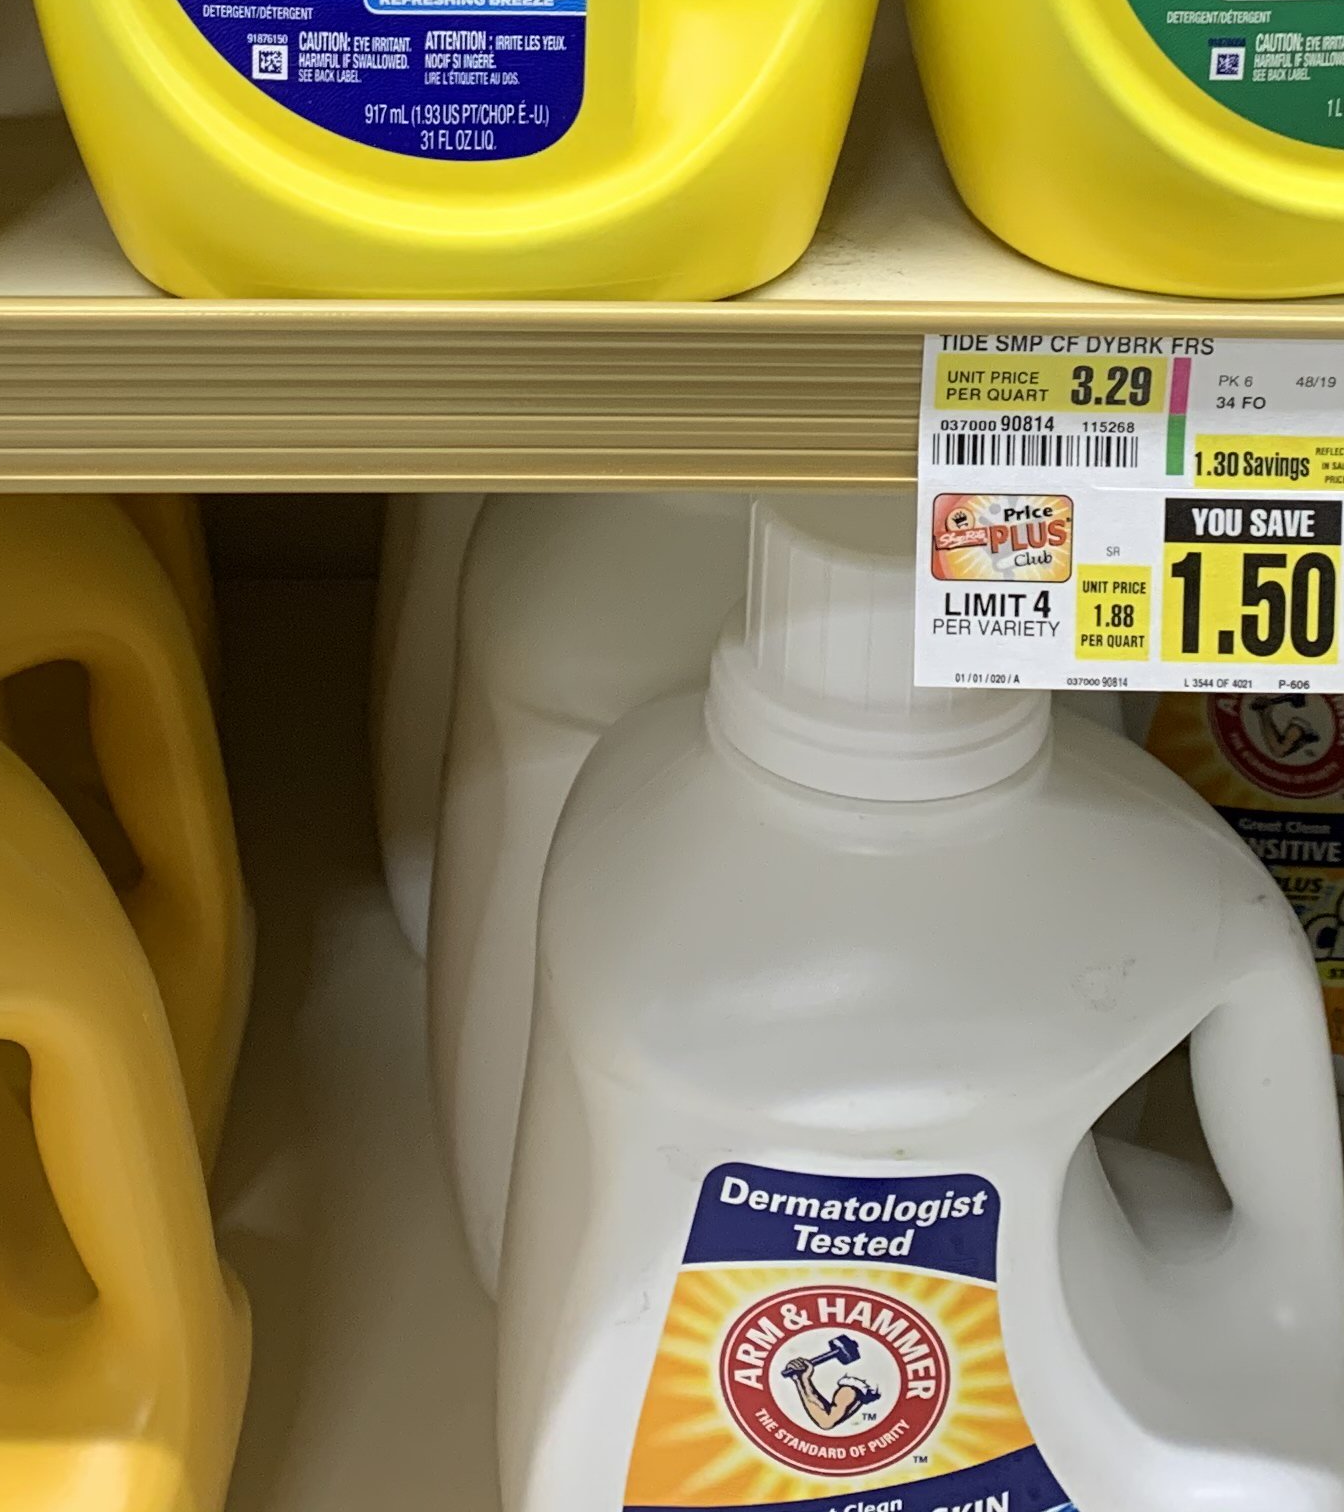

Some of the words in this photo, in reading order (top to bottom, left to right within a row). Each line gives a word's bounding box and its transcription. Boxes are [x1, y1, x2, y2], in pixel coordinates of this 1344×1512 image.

[298, 31, 351, 51] CAUTION:
[365, 104, 387, 124] 917
[390, 105, 409, 125] mL
[420, 131, 436, 150] 31
[438, 131, 454, 150] FL
[455, 131, 473, 150] OZ
[475, 131, 497, 152] LIQ.
[940, 335, 988, 351] TIDE
[995, 335, 1043, 352] SMP
[1051, 336, 1079, 353] CF
[1086, 337, 1164, 354] DYBRK
[1171, 338, 1214, 355] FRS
[947, 371, 985, 384] UNIT
[990, 372, 1040, 384] PRICE
[1071, 366, 1153, 406] 3.29
[1218, 376, 1239, 387] PK
[1244, 376, 1253, 387] 6
[1296, 376, 1337, 388] 48/19
[946, 388, 981, 400] PER
[987, 389, 1049, 402] QUART
[1216, 397, 1235, 409] 34
[1242, 397, 1266, 409] FO
[940, 420, 996, 431] 037000
[1001, 415, 1054, 432] 90814
[1082, 422, 1135, 433] 115268
[1194, 451, 1239, 477] 1.30
[1243, 451, 1310, 481] Savings
[1005, 505, 1053, 522] Price
[1192, 508, 1242, 537] YOU
[1250, 508, 1315, 538] SAVE
[989, 519, 1068, 553] PLUS
[1014, 551, 1052, 567] Club
[1082, 581, 1107, 594] UNIT
[1113, 581, 1146, 594] PRICE
[945, 593, 1027, 617] LIMIT
[1033, 590, 1051, 618] 4
[1171, 552, 1336, 658] 1.50
[1094, 604, 1134, 627] 1.88
[933, 619, 971, 635] PER
[978, 620, 1060, 637] VARIETY
[1081, 635, 1103, 647] PER
[1107, 635, 1145, 648] QUART
[1278, 680, 1310, 690] P-606
[720, 1175, 988, 1226] Dermatologist
[792, 1224, 916, 1257] Tested
[734, 1316, 782, 1391] ARM
[782, 1302, 813, 1330] &
[817, 1297, 936, 1400] HAMMER
[754, 1407, 779, 1436] THE
[775, 1426, 848, 1460] STANDARD
[850, 1443, 867, 1459] OF
[868, 1418, 911, 1453] PURITY
